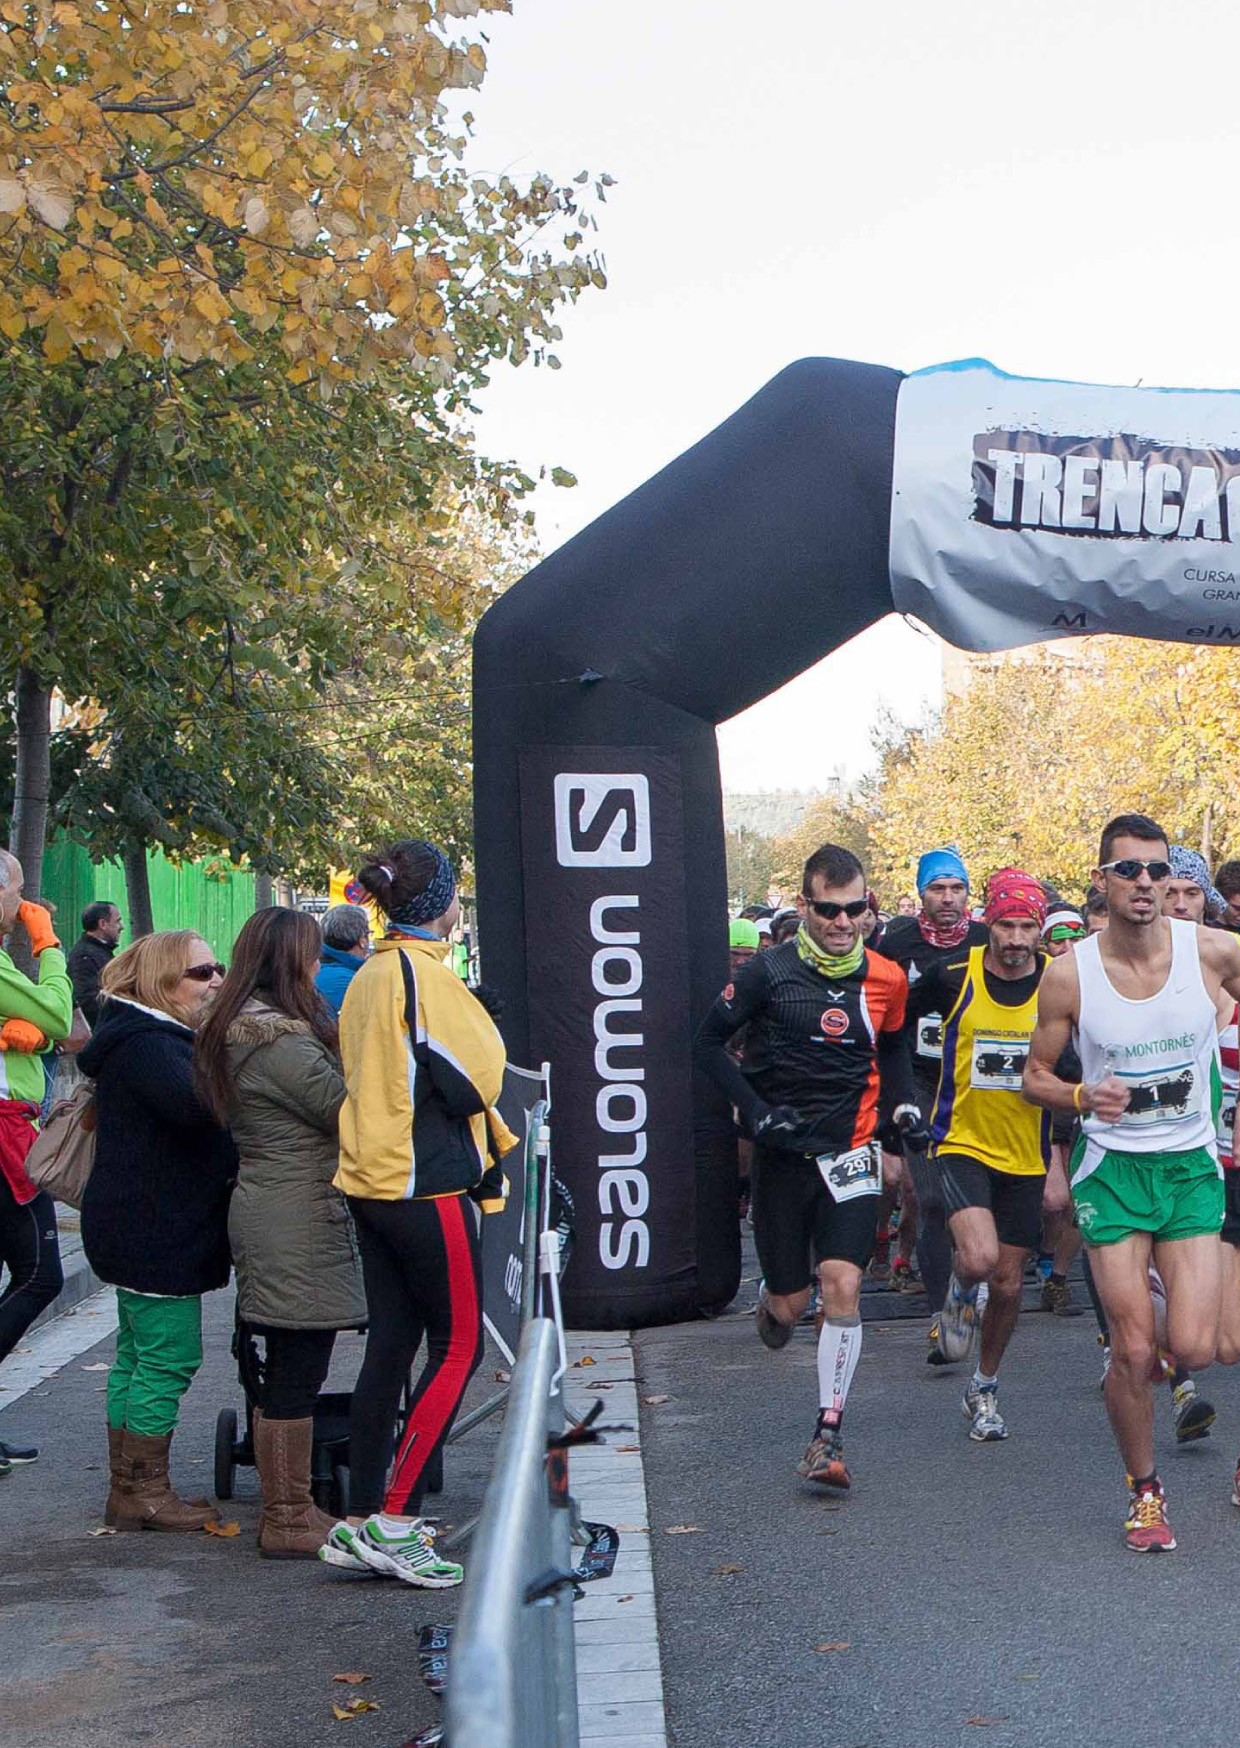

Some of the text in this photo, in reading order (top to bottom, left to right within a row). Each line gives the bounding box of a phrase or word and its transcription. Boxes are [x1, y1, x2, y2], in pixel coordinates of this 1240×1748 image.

[1183, 568, 1237, 585] CURSA
[1124, 1032, 1196, 1058] MONTORNÈS
[1003, 1055, 1014, 1069] 2
[589, 894, 650, 1270] salomon
[1149, 1085, 1160, 1102] 1
[842, 1157, 871, 1177] 297
